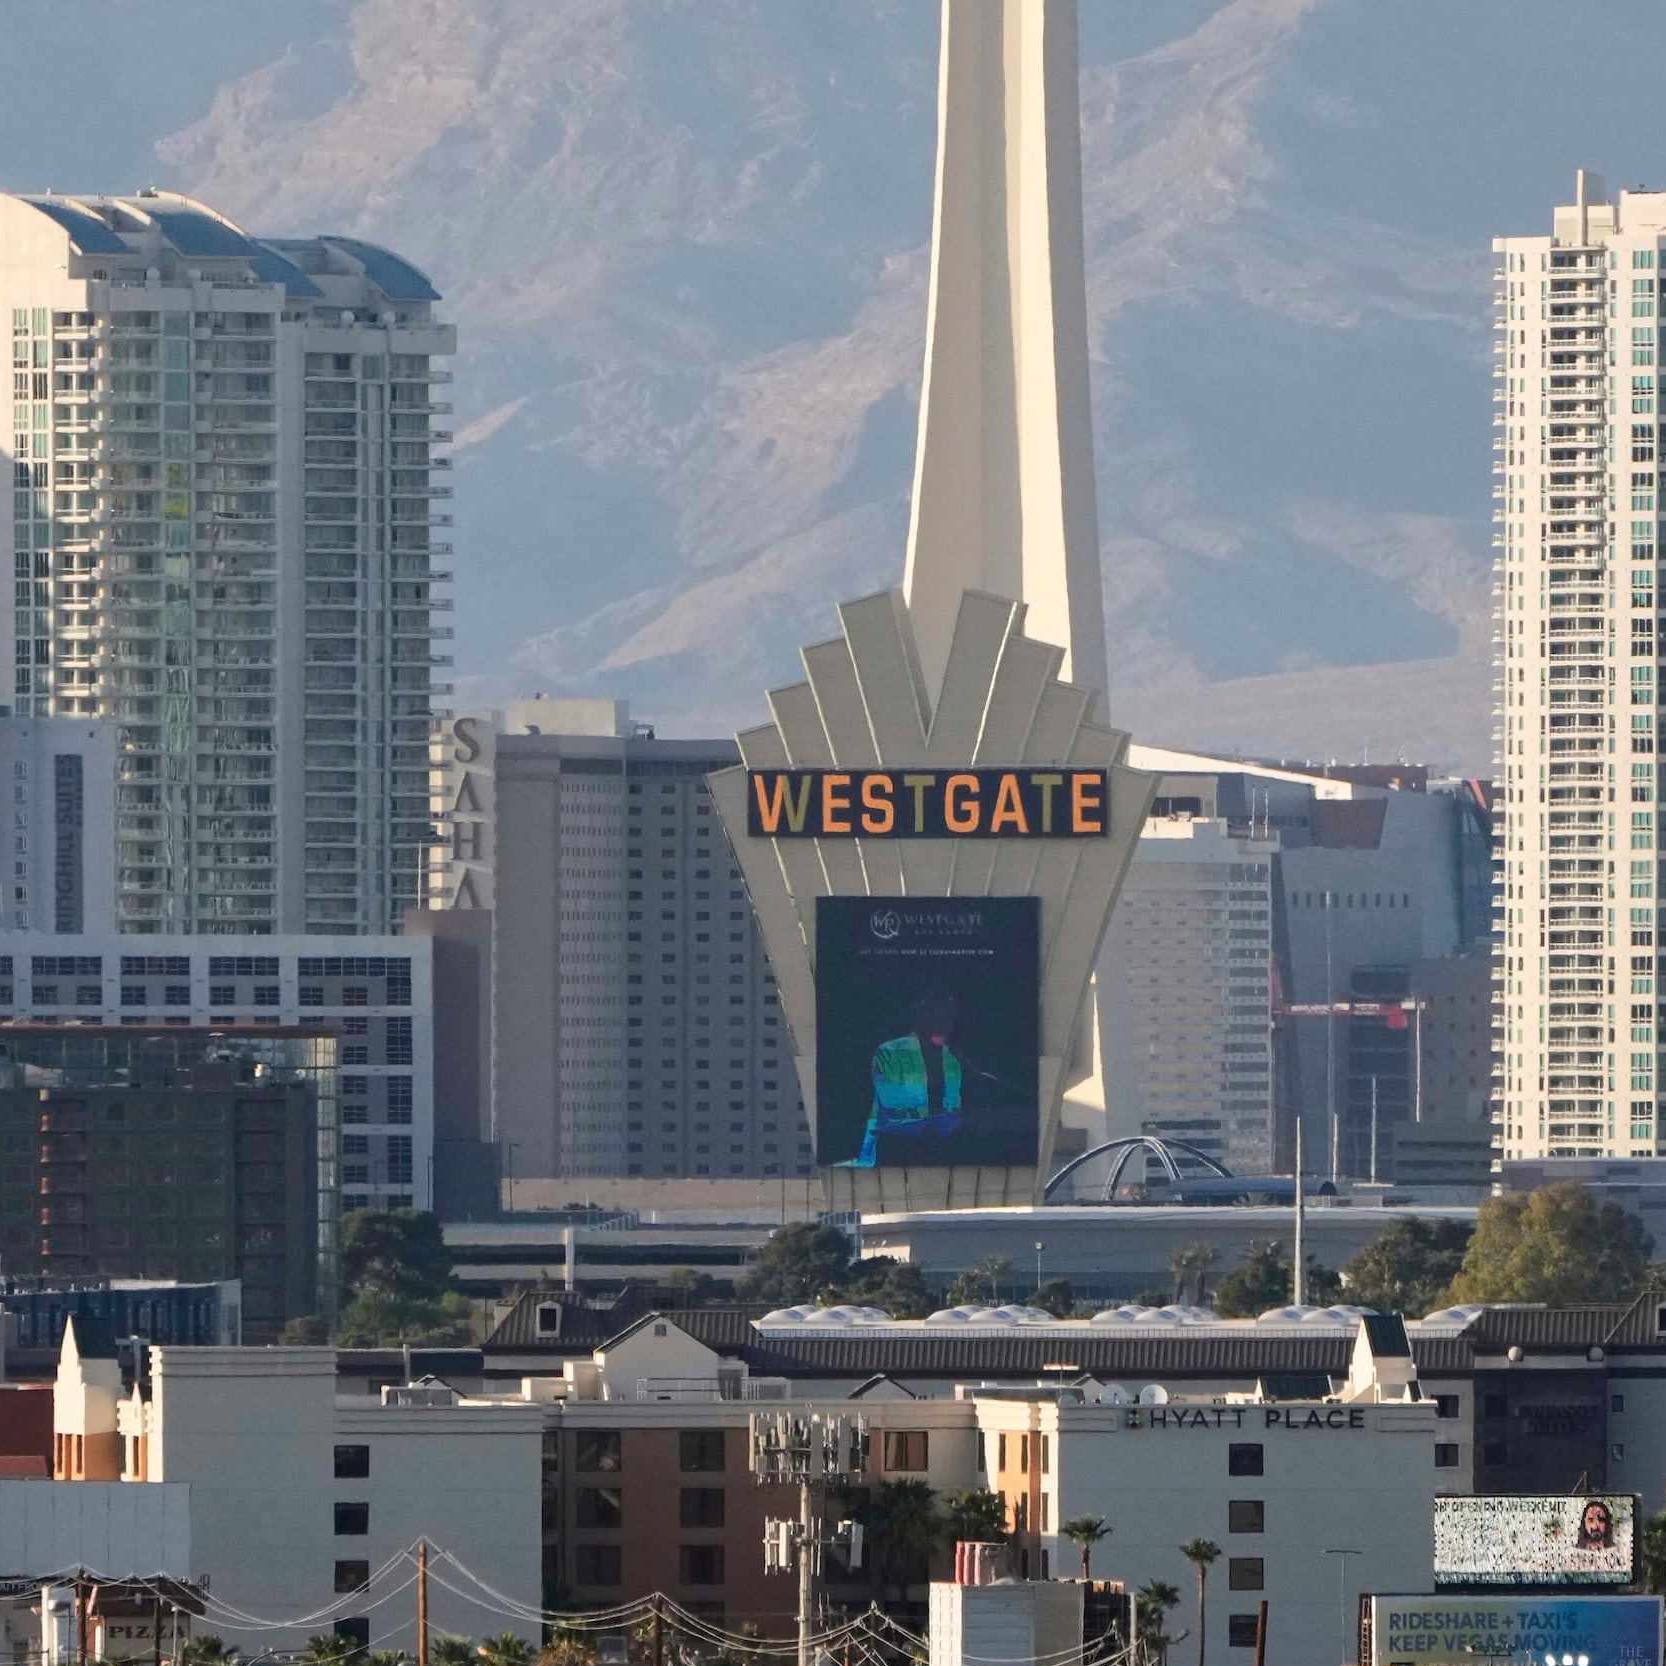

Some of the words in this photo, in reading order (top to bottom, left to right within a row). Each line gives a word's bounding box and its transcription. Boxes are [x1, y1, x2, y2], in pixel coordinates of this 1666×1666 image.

[451, 718, 485, 908] SAHA
[754, 774, 1101, 833] WESTGATE
[1150, 1408, 1246, 1429] HYATT
[1265, 1408, 1365, 1429] PLACE
[1389, 1612, 1499, 1630] RIDESHARE
[1517, 1611, 1577, 1630] TAXI'S
[108, 1625, 183, 1640] PIZZA
[1389, 1634, 1438, 1652] KEEP
[1443, 1633, 1507, 1652] VEGAS
[1514, 1633, 1598, 1651] MOVING
